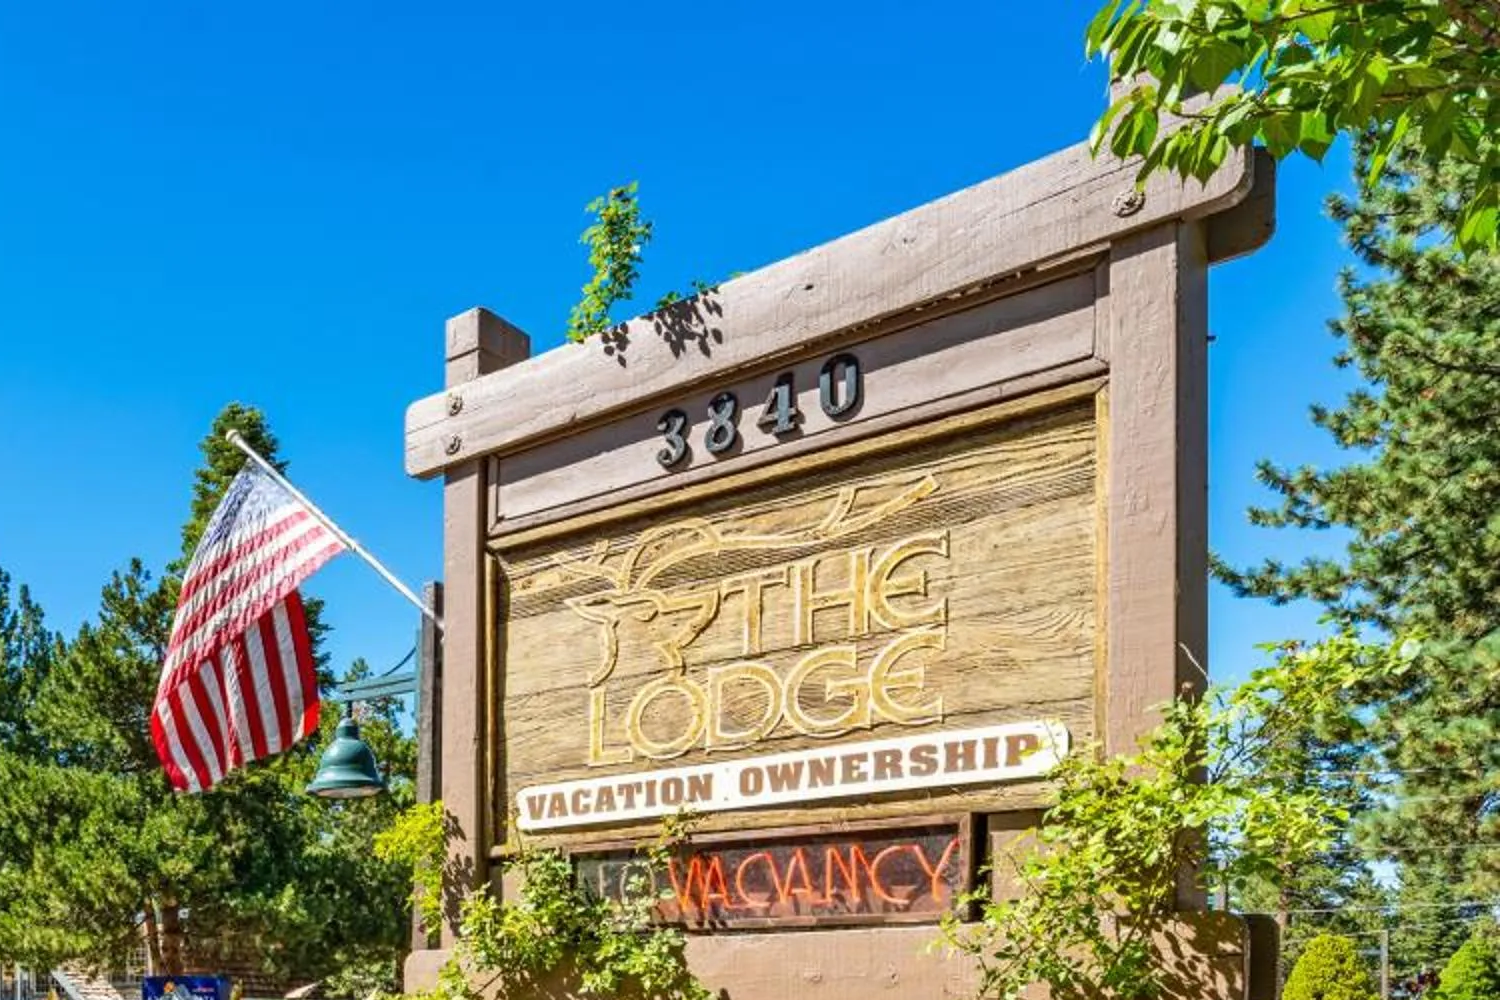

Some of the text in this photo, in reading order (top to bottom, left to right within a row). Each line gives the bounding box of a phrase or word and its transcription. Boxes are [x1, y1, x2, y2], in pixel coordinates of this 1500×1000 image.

[657, 352, 861, 467] 3840
[721, 529, 951, 655] THE
[587, 626, 947, 766] LODGE
[526, 733, 1040, 821] VACATION OWNERSHIP
[667, 837, 962, 913] VACANCY
